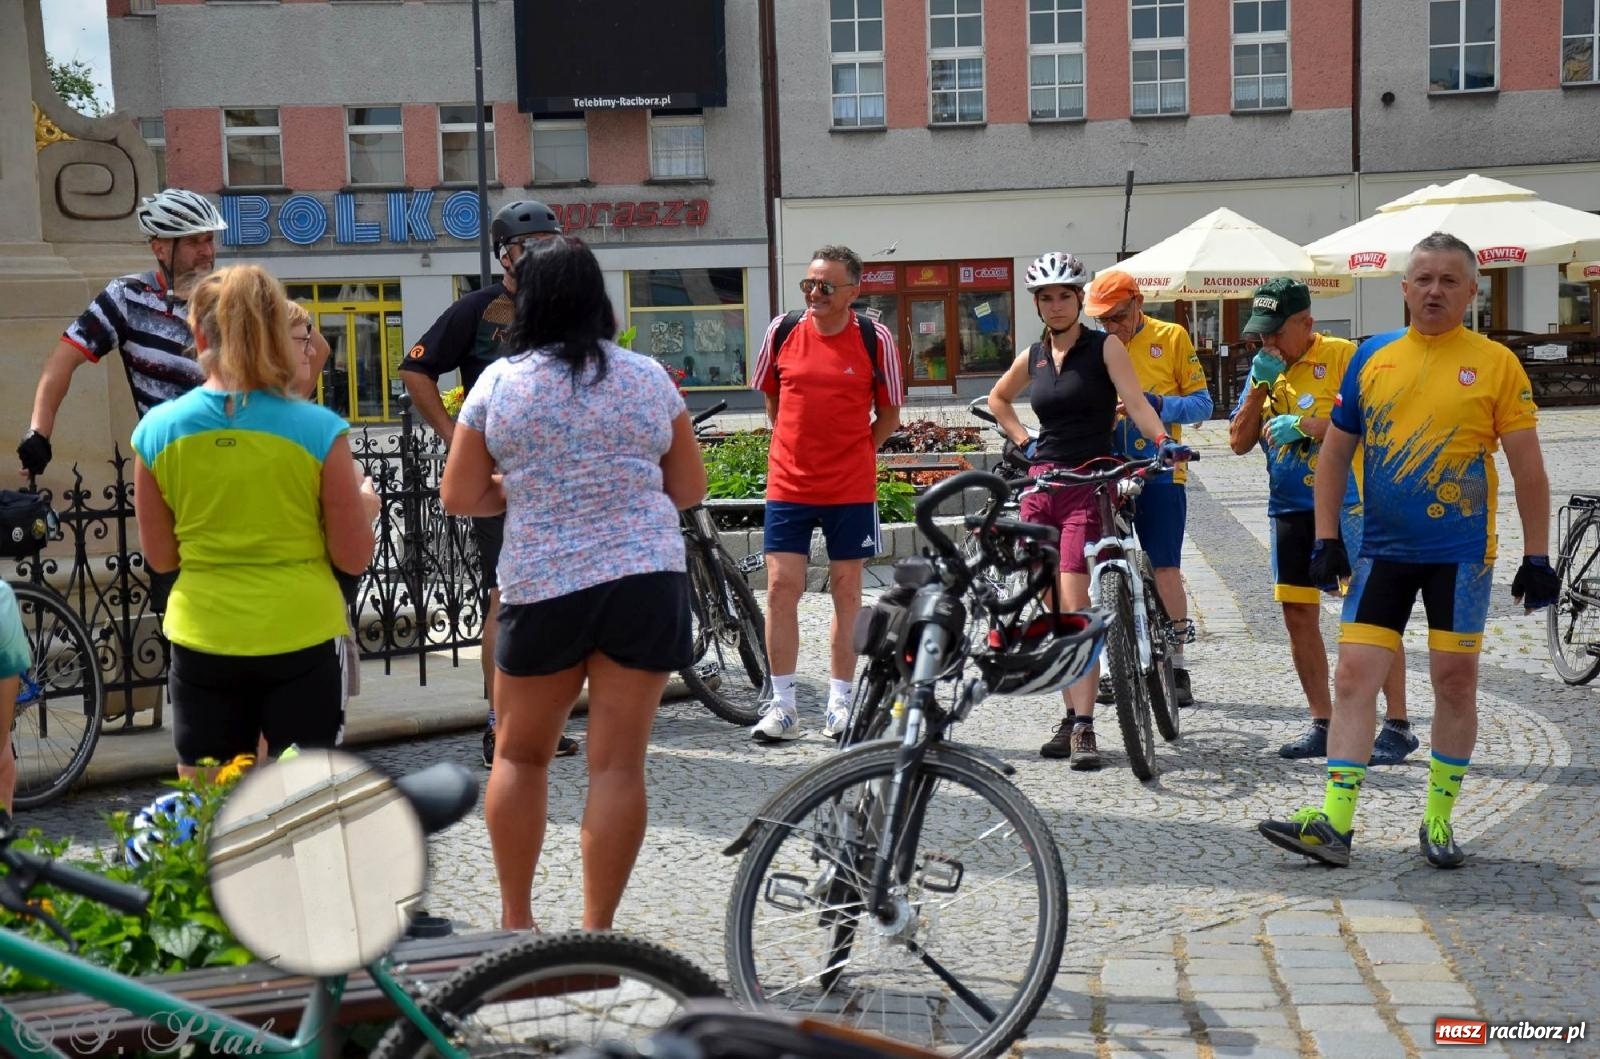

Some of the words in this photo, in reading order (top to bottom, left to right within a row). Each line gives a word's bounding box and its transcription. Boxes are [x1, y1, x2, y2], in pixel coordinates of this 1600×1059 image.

[572, 95, 671, 108] Telebimy-Raciborz.pl
[221, 190, 490, 246] BOLKO
[547, 199, 709, 236] prasza
